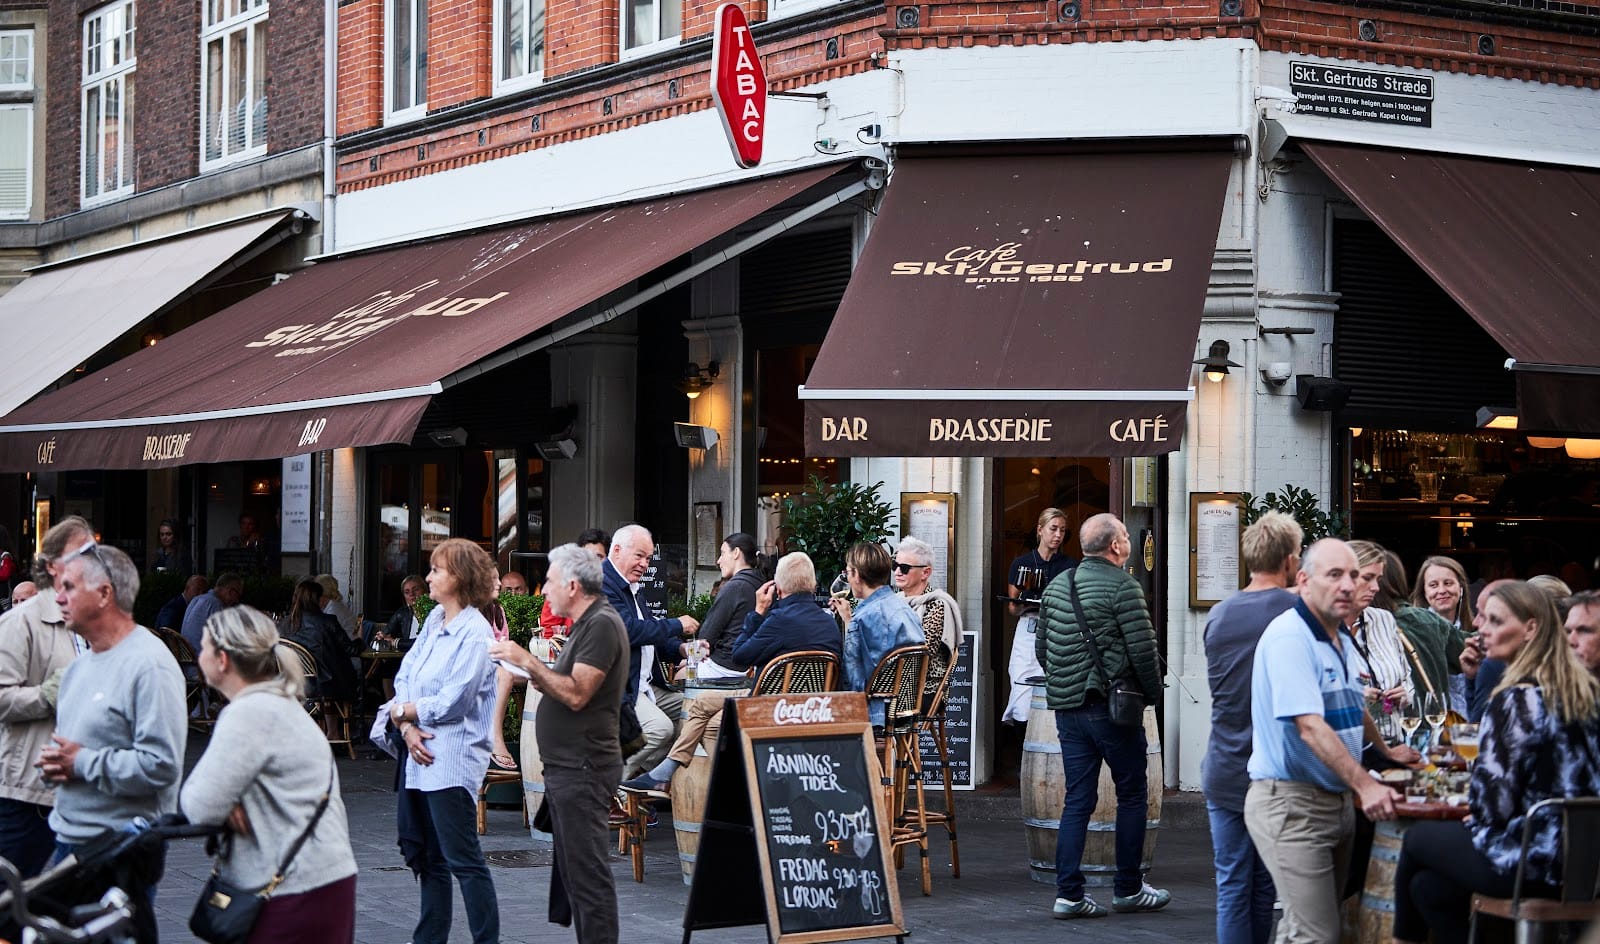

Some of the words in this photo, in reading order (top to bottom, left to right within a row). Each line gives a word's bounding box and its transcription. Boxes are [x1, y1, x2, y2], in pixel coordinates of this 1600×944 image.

[732, 25, 761, 142] TABAC
[1294, 66, 1319, 82] Skt.
[1324, 70, 1378, 89] Gertruds
[1383, 76, 1428, 94] Stræde
[1351, 108, 1378, 118] Gertruds
[1379, 111, 1396, 120] Kapel
[944, 242, 1023, 273] Café
[989, 258, 1173, 276] Gertrud
[964, 275, 1020, 283] anno
[1029, 275, 1083, 283] 1986
[37, 436, 56, 465] CAFÉ
[142, 432, 192, 462] BRASSERIE
[298, 417, 328, 447] BAR
[821, 416, 868, 442] BAR
[928, 418, 1053, 442] BRASSERIE
[1109, 413, 1168, 442] CAFÉ
[773, 696, 834, 726] Coca-Cola
[766, 746, 841, 776] ÅBNINGS-
[799, 774, 847, 793] TIDER
[779, 858, 829, 882] FREDAG
[783, 885, 839, 909] LØRDAG
